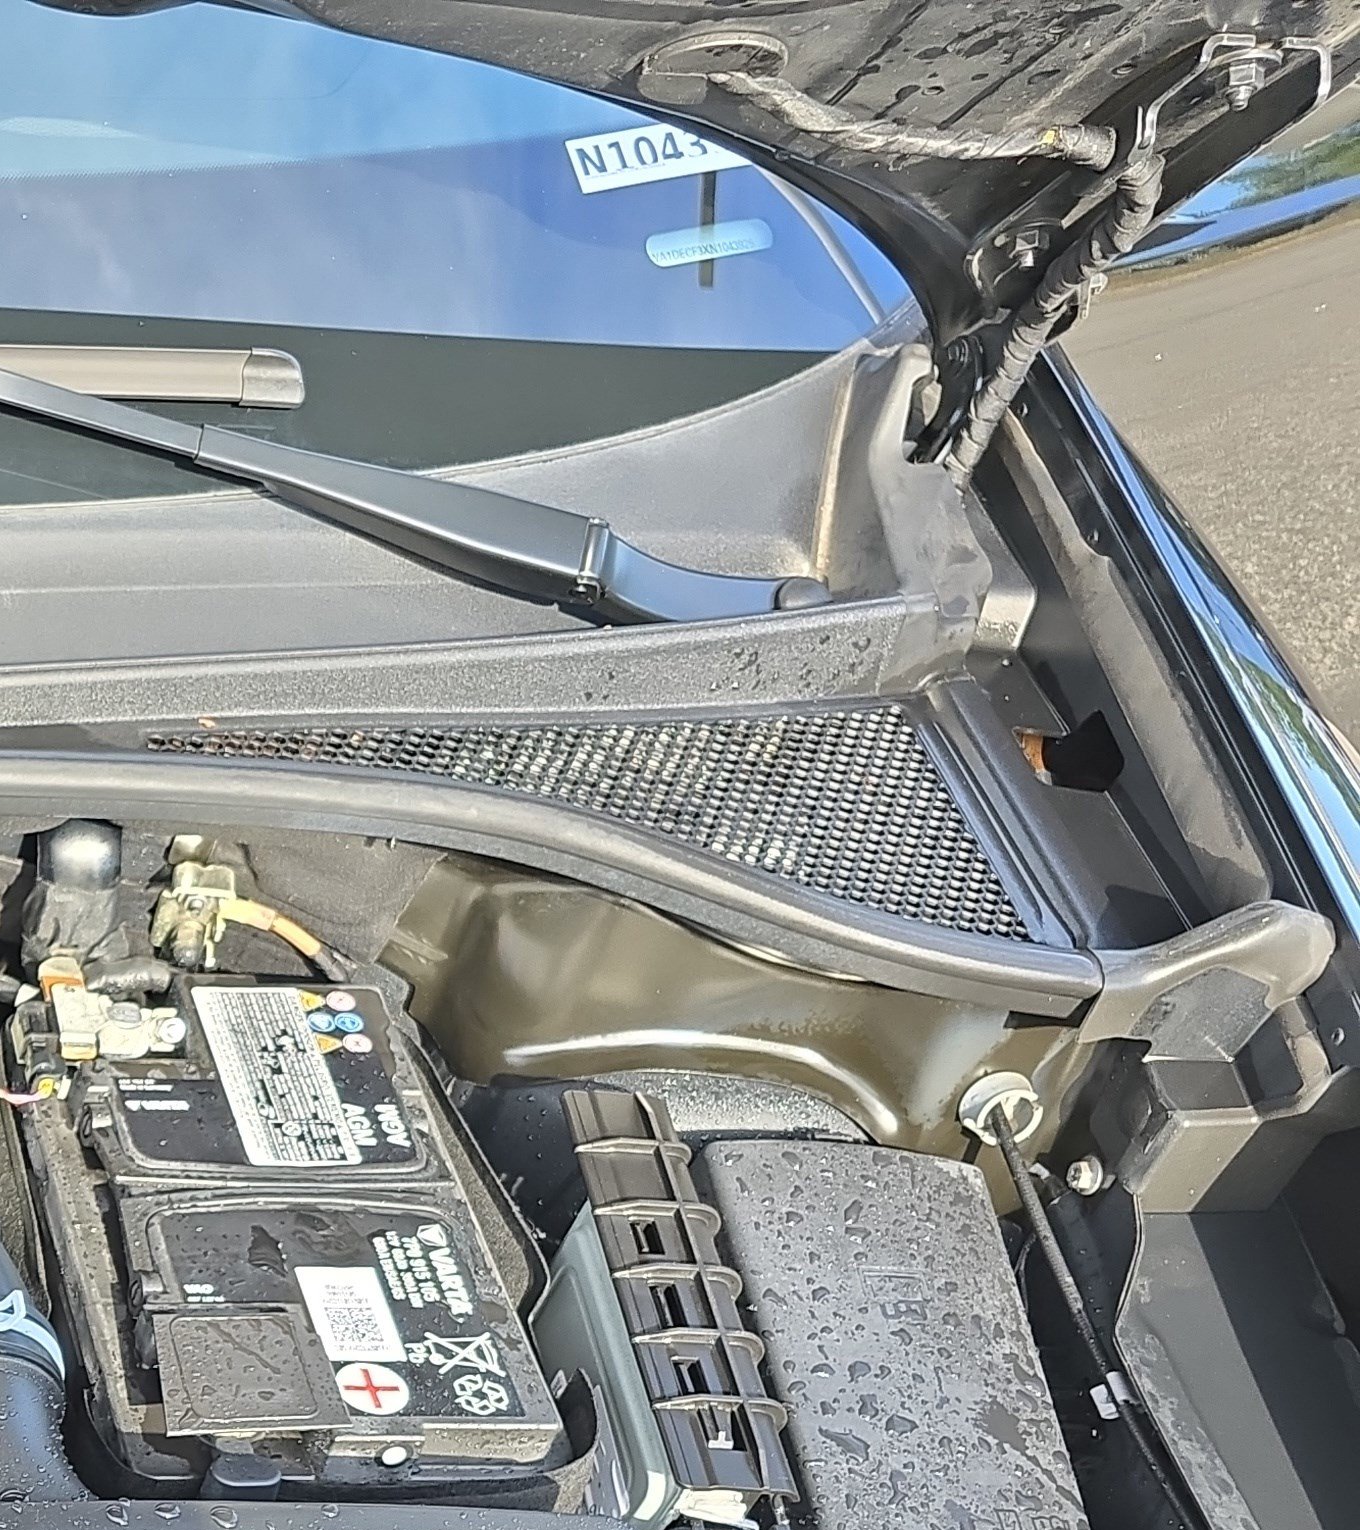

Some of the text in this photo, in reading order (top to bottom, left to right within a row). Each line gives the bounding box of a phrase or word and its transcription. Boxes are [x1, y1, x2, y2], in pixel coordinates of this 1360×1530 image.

[576, 131, 718, 177] N1043
[341, 1103, 378, 1146] AGM
[374, 1104, 412, 1148] AGM
[429, 1248, 473, 1315] VARTA
[404, 1343, 427, 1364] Pb
